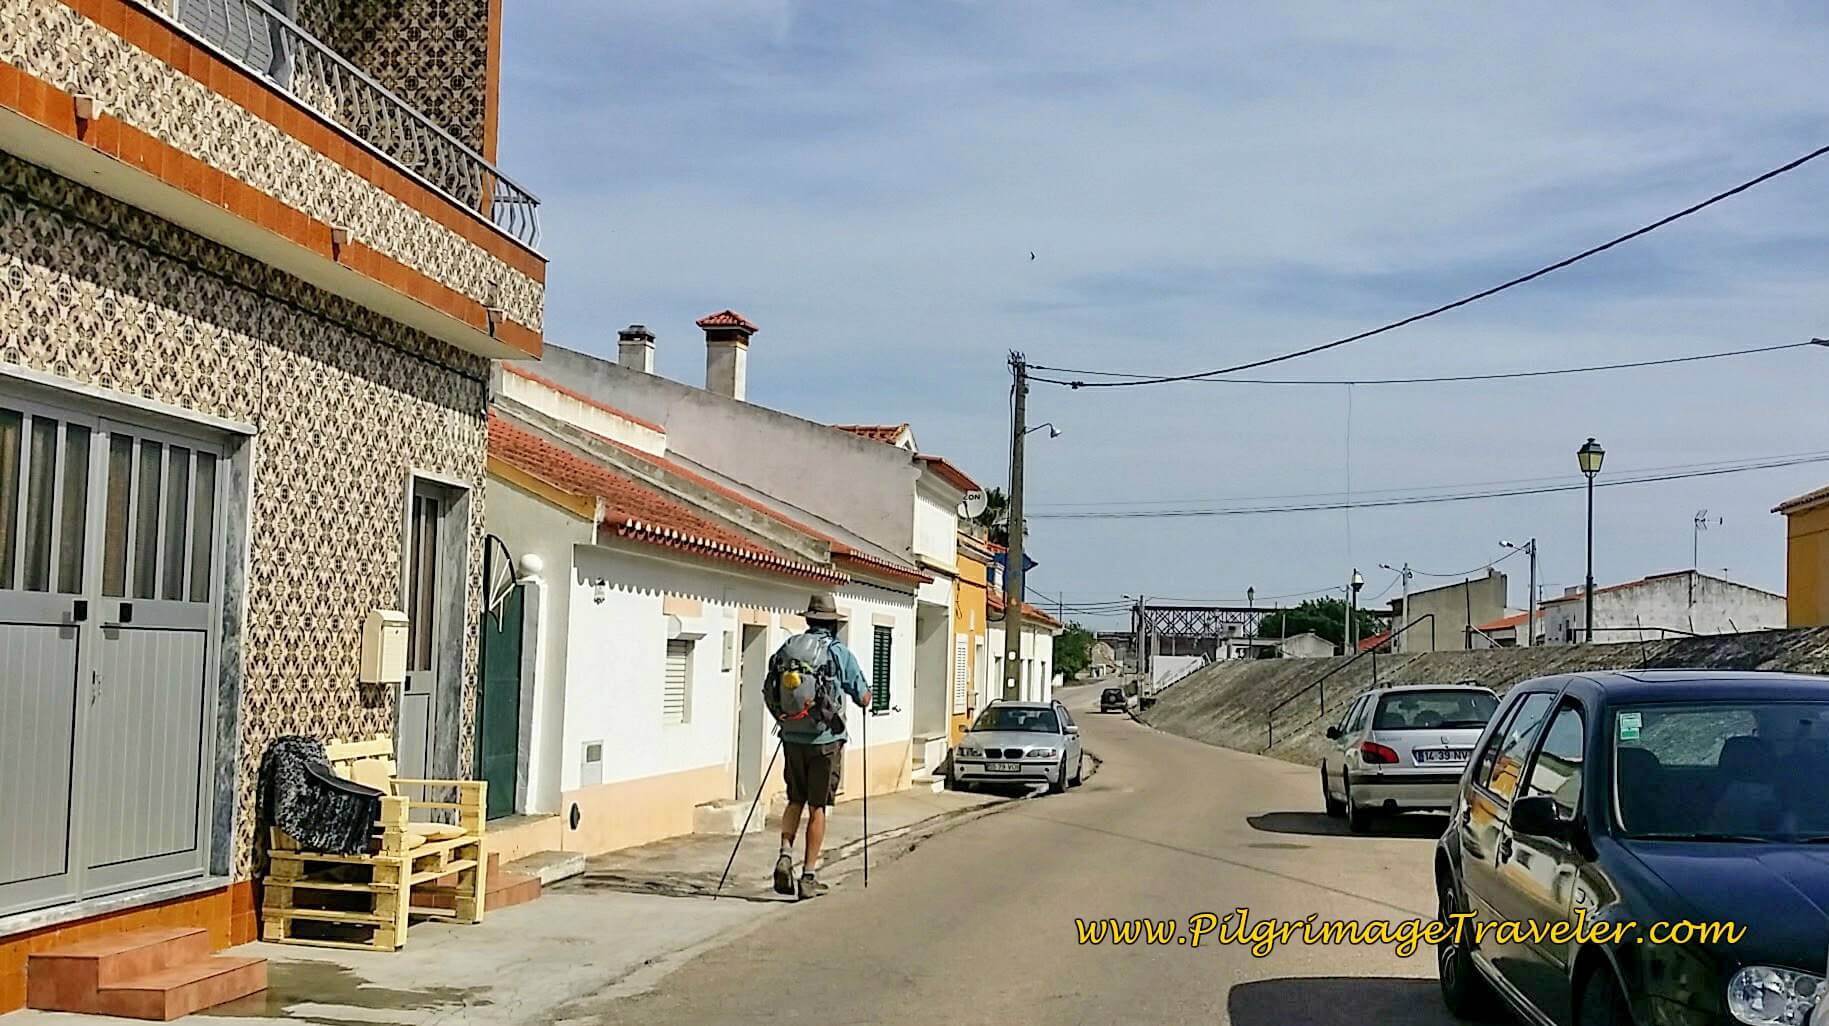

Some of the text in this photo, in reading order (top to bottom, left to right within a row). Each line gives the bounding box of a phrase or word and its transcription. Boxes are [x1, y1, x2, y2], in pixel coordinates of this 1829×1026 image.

[1425, 751, 1468, 760] 14 39 NV
